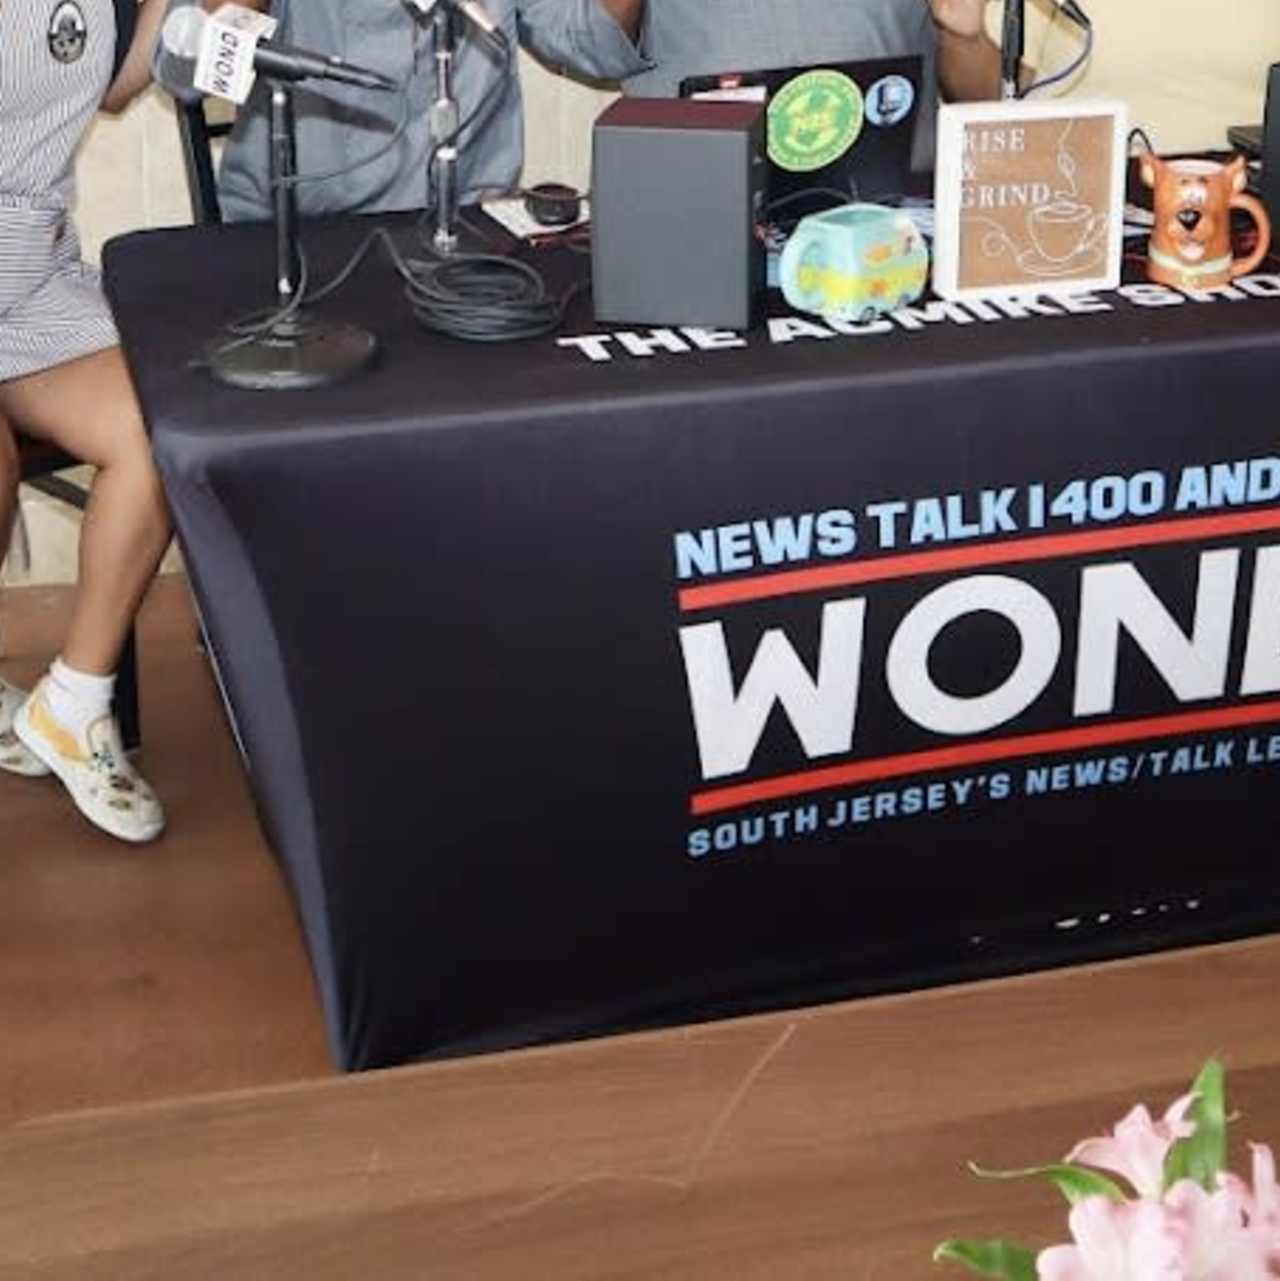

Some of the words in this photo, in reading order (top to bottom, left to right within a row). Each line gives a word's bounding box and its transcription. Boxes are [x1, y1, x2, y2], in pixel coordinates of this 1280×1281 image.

[960, 181, 1051, 210] GRIND
[556, 325, 749, 363] THE
[673, 508, 860, 579] NEWS
[865, 487, 1019, 550] TALK
[1027, 472, 1165, 530] 1400
[686, 804, 819, 858] SOUTH
[826, 773, 1012, 830] JERSEY'S
[1025, 740, 1235, 797] NEWS/TALK
